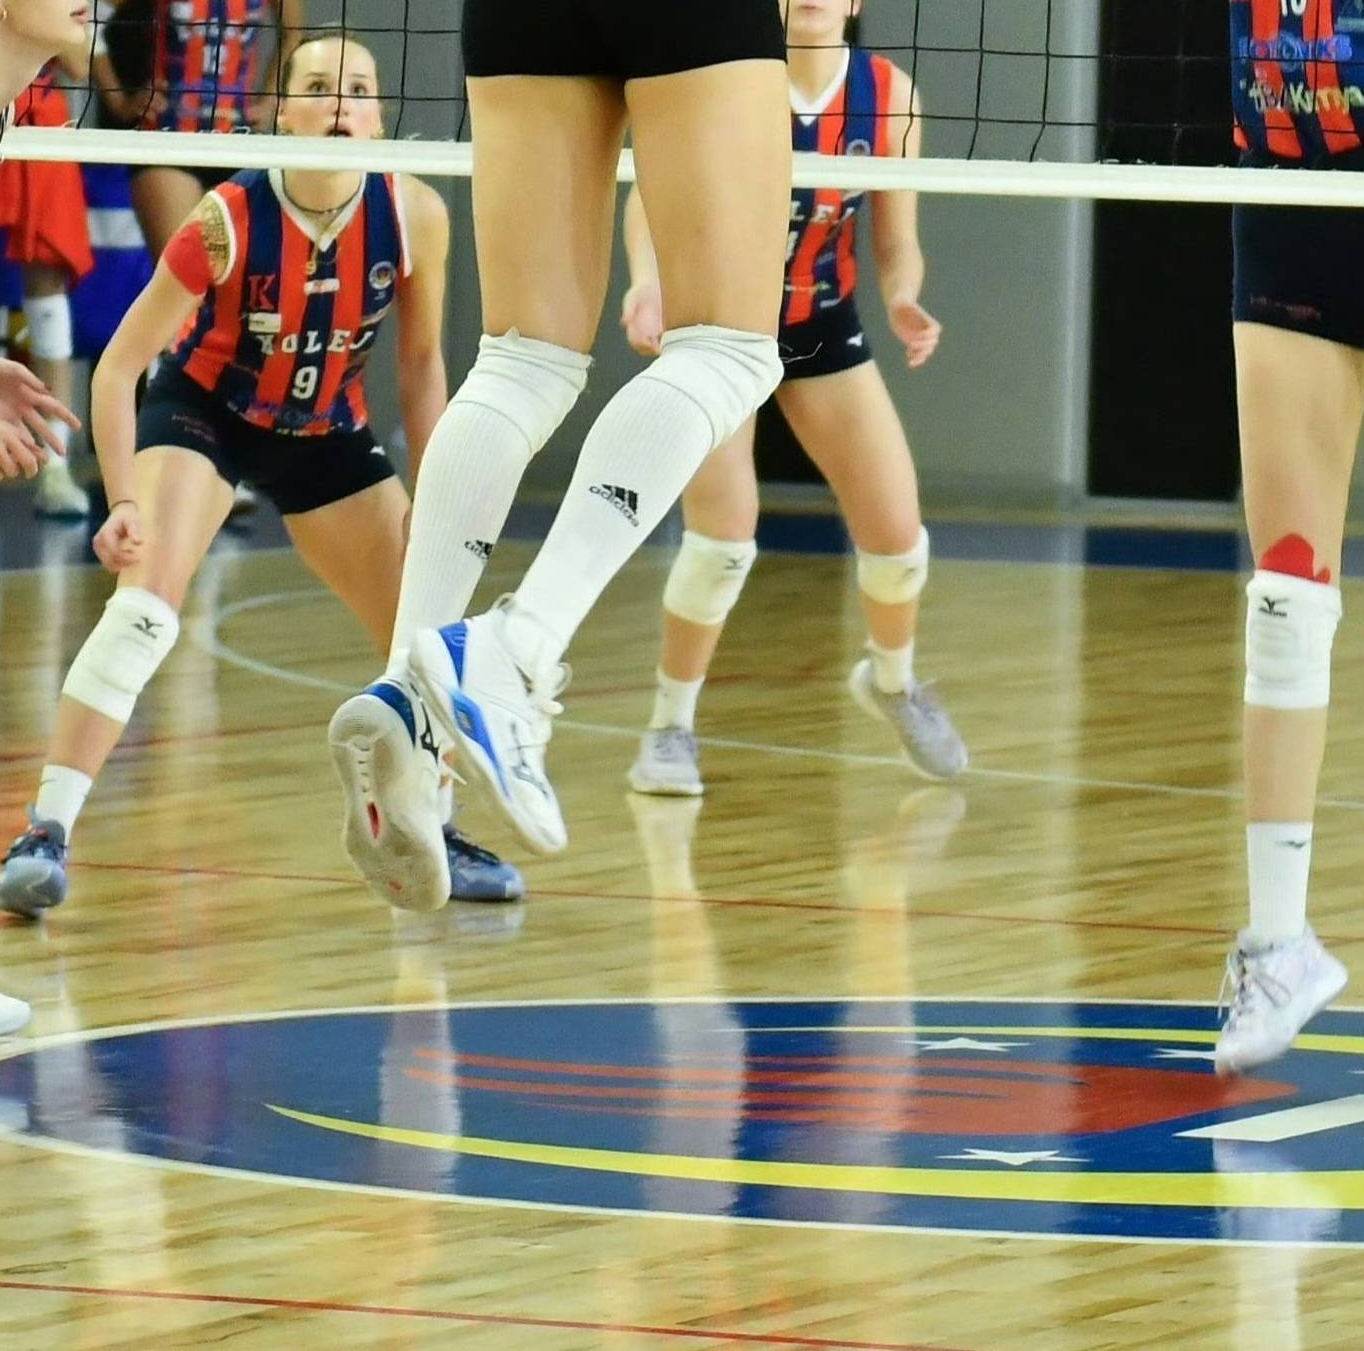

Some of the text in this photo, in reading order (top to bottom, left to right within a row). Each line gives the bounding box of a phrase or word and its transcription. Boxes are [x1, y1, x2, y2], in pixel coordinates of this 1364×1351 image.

[255, 329, 375, 356] KOLEJ
[291, 365, 319, 400] 9
[589, 486, 640, 528] adidas
